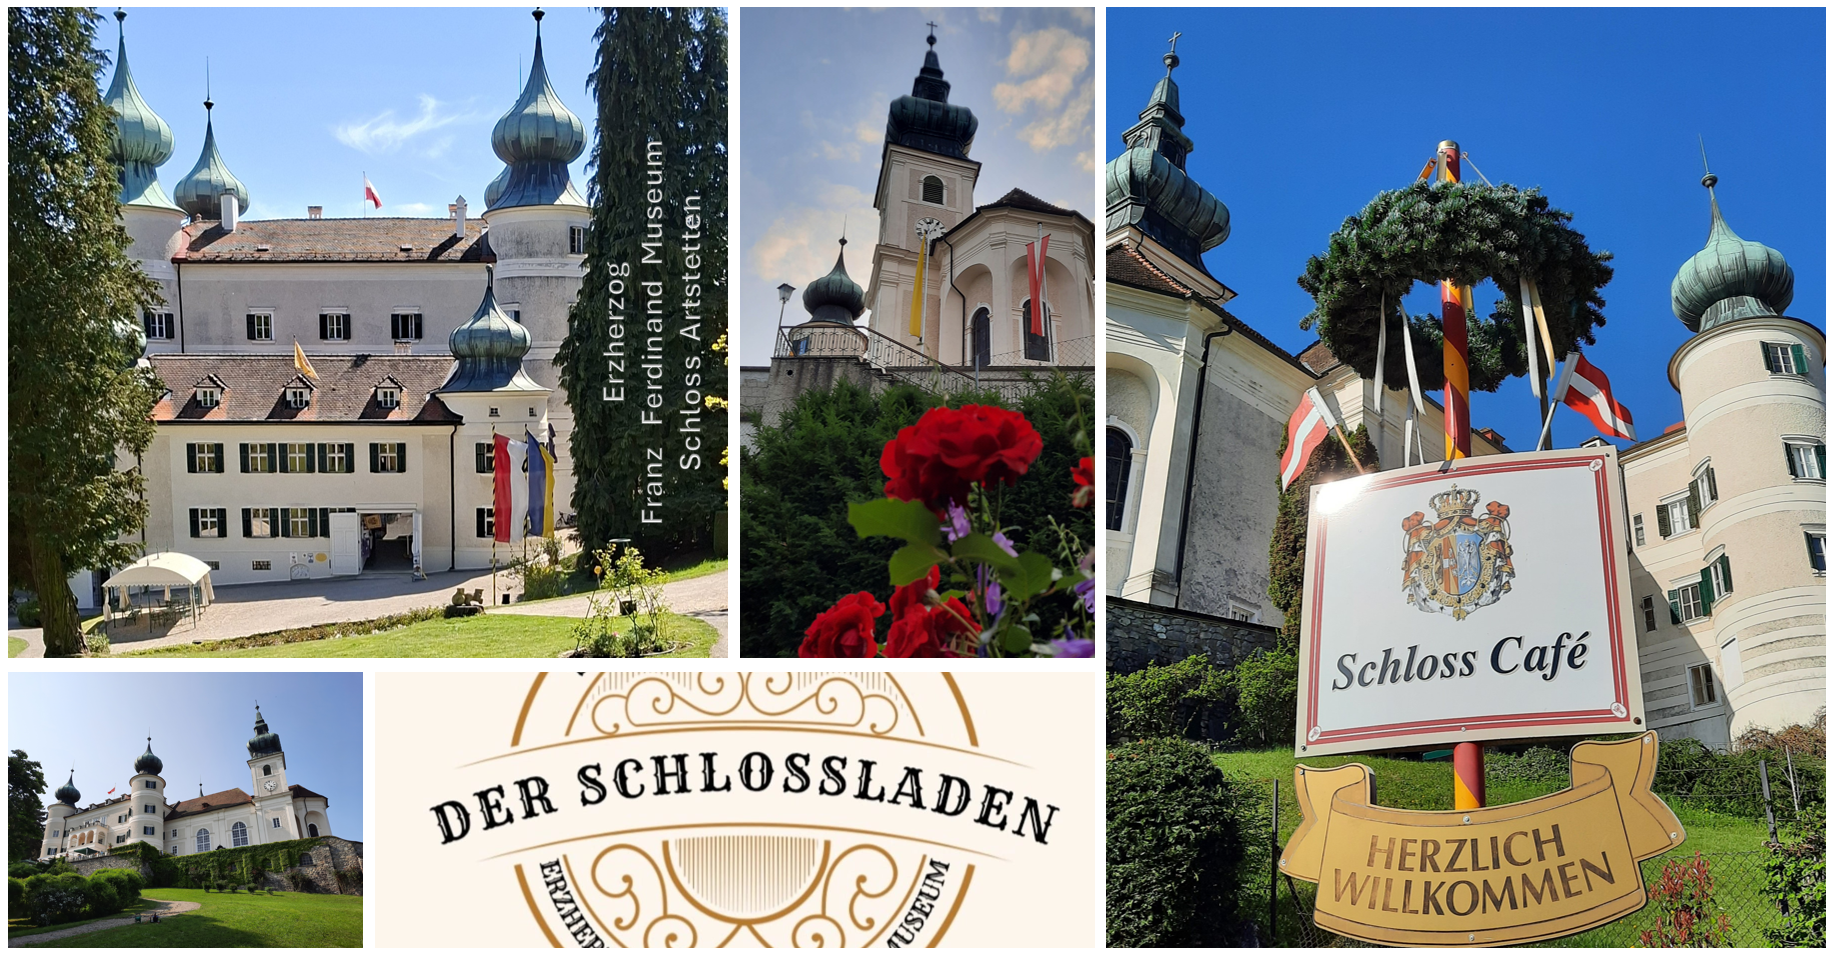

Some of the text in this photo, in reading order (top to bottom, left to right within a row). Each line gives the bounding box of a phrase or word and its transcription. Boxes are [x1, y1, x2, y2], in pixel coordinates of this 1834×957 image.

[1332, 630, 1591, 691] Schloss Café
[430, 751, 1061, 845] DER SCHLOSSLADEN
[1366, 823, 1565, 873] HERZLICH
[1333, 851, 1615, 916] WILLKOMMEN
